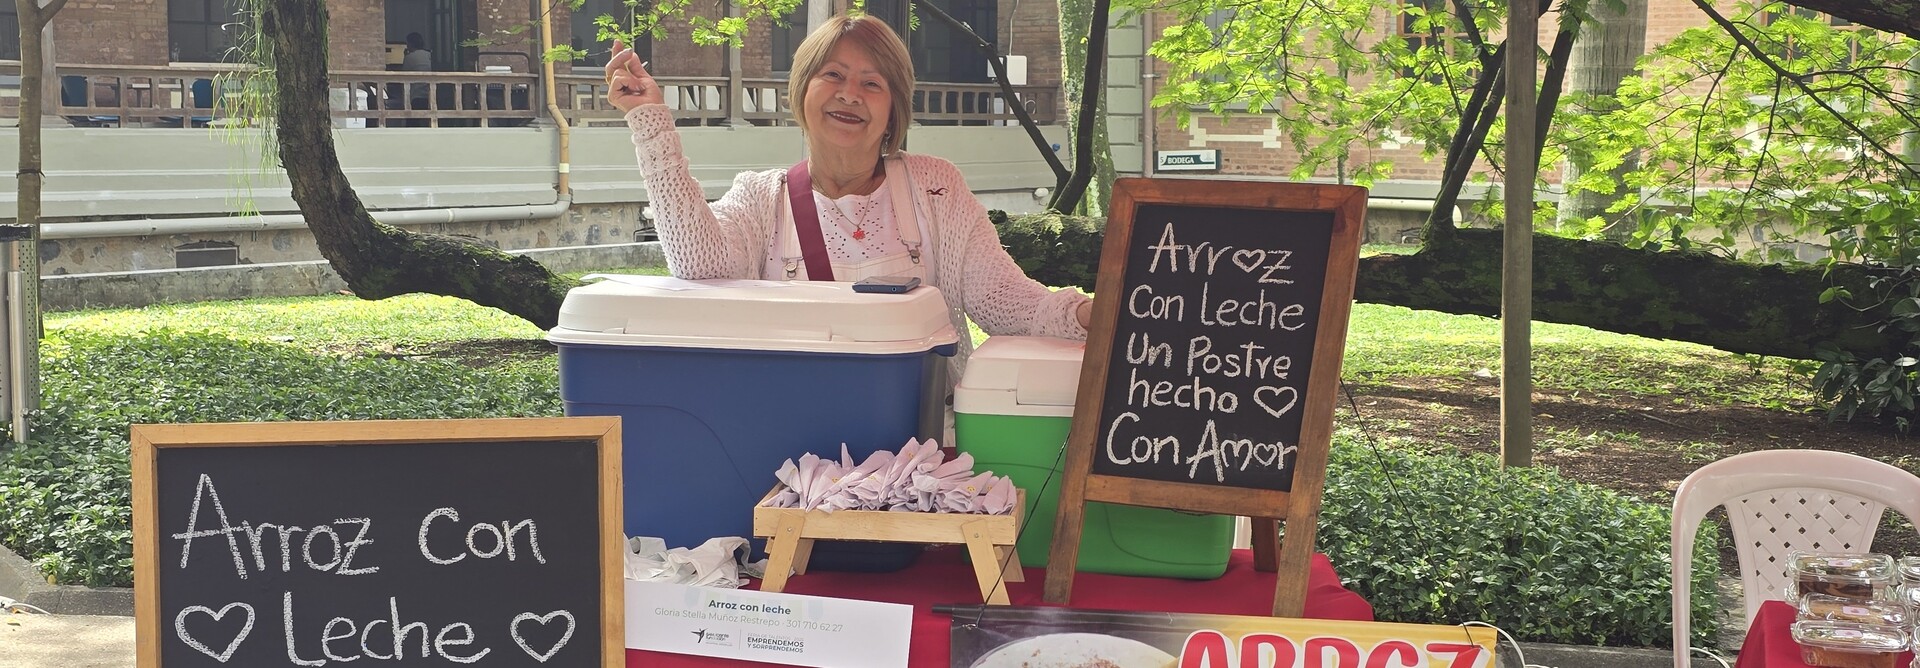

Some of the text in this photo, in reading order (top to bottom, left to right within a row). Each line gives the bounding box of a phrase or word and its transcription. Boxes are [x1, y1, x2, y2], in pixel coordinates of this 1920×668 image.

[1129, 282, 1305, 331] Con Leche
[1126, 332, 1291, 379] Un Postre
[1128, 368, 1238, 413] hecho
[1107, 412, 1179, 465] Con
[172, 473, 546, 579] Arroz Con
[283, 591, 491, 667] Leche
[655, 607, 680, 617] Gloria
[682, 610, 706, 619] Stella
[708, 612, 738, 622] Muñoz
[740, 615, 780, 627] Restrepo
[786, 619, 801, 629] 301
[803, 621, 818, 630] 710
[820, 622, 831, 632] 62
[832, 624, 843, 632] 27
[708, 600, 791, 615] Arroz con leche
[747, 637, 804, 648] EMPRENDEMOS
[752, 644, 804, 653] SORPRENDEMOS
